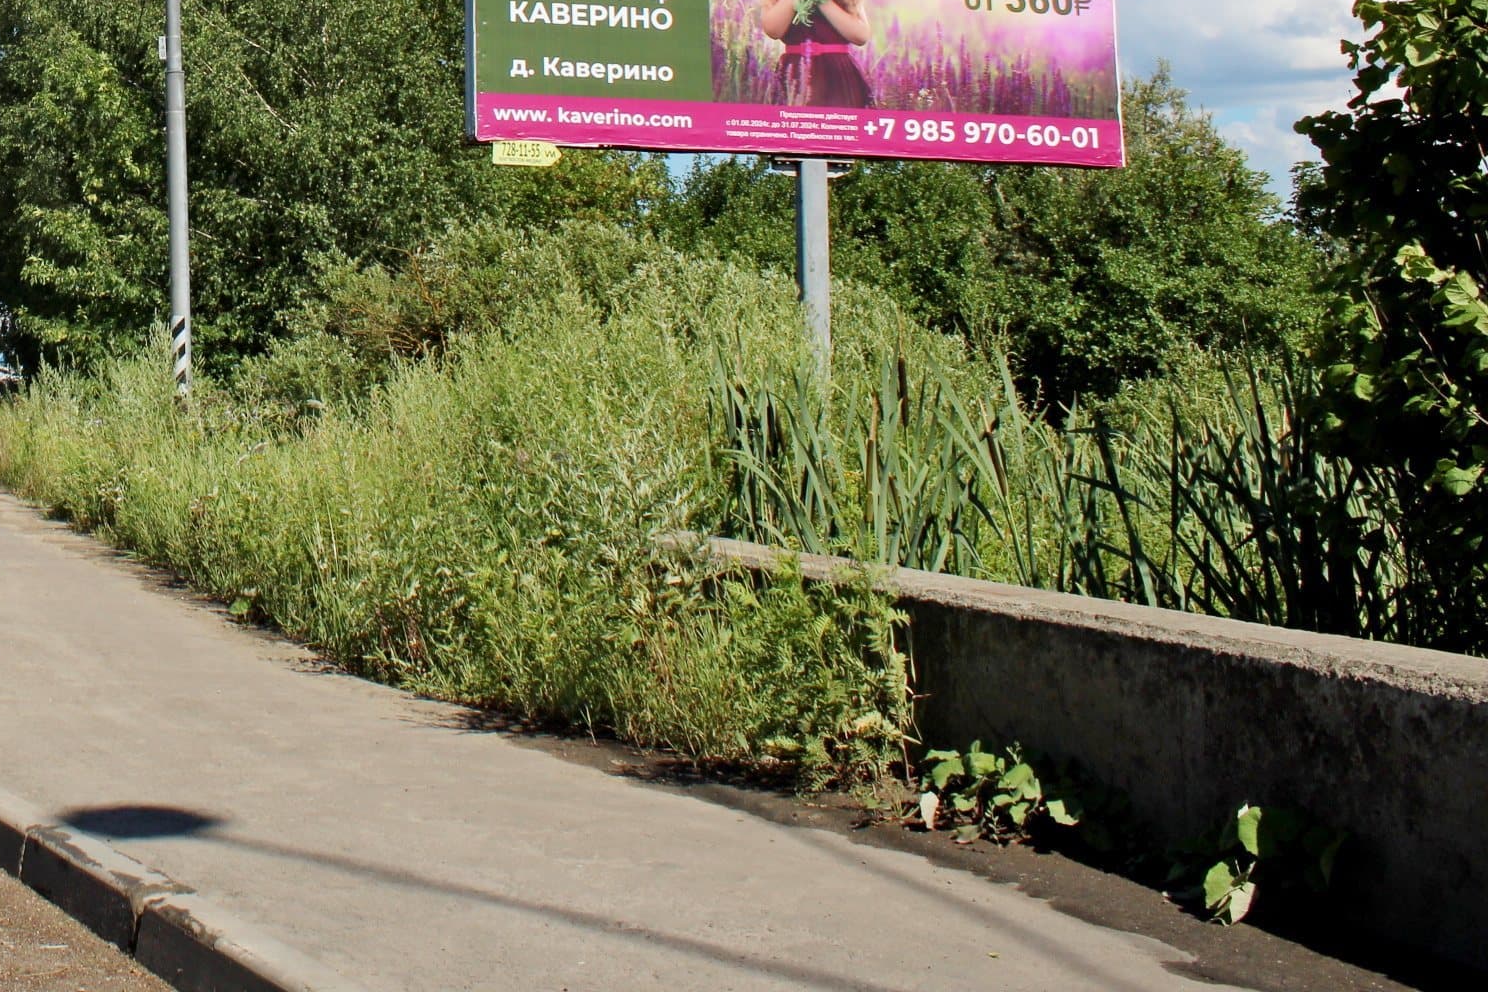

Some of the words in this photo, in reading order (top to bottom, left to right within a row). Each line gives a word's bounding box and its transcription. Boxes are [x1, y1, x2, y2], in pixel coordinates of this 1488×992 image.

[509, 0, 673, 30] КАВЕРИНО
[510, 58, 535, 78] д.
[543, 56, 674, 84] Каверино
[557, 106, 692, 128] kaverino.com
[863, 118, 896, 140] +7
[904, 119, 956, 142] 985
[963, 122, 1099, 149] 970-60-01
[502, 142, 541, 158] 728-11-55
